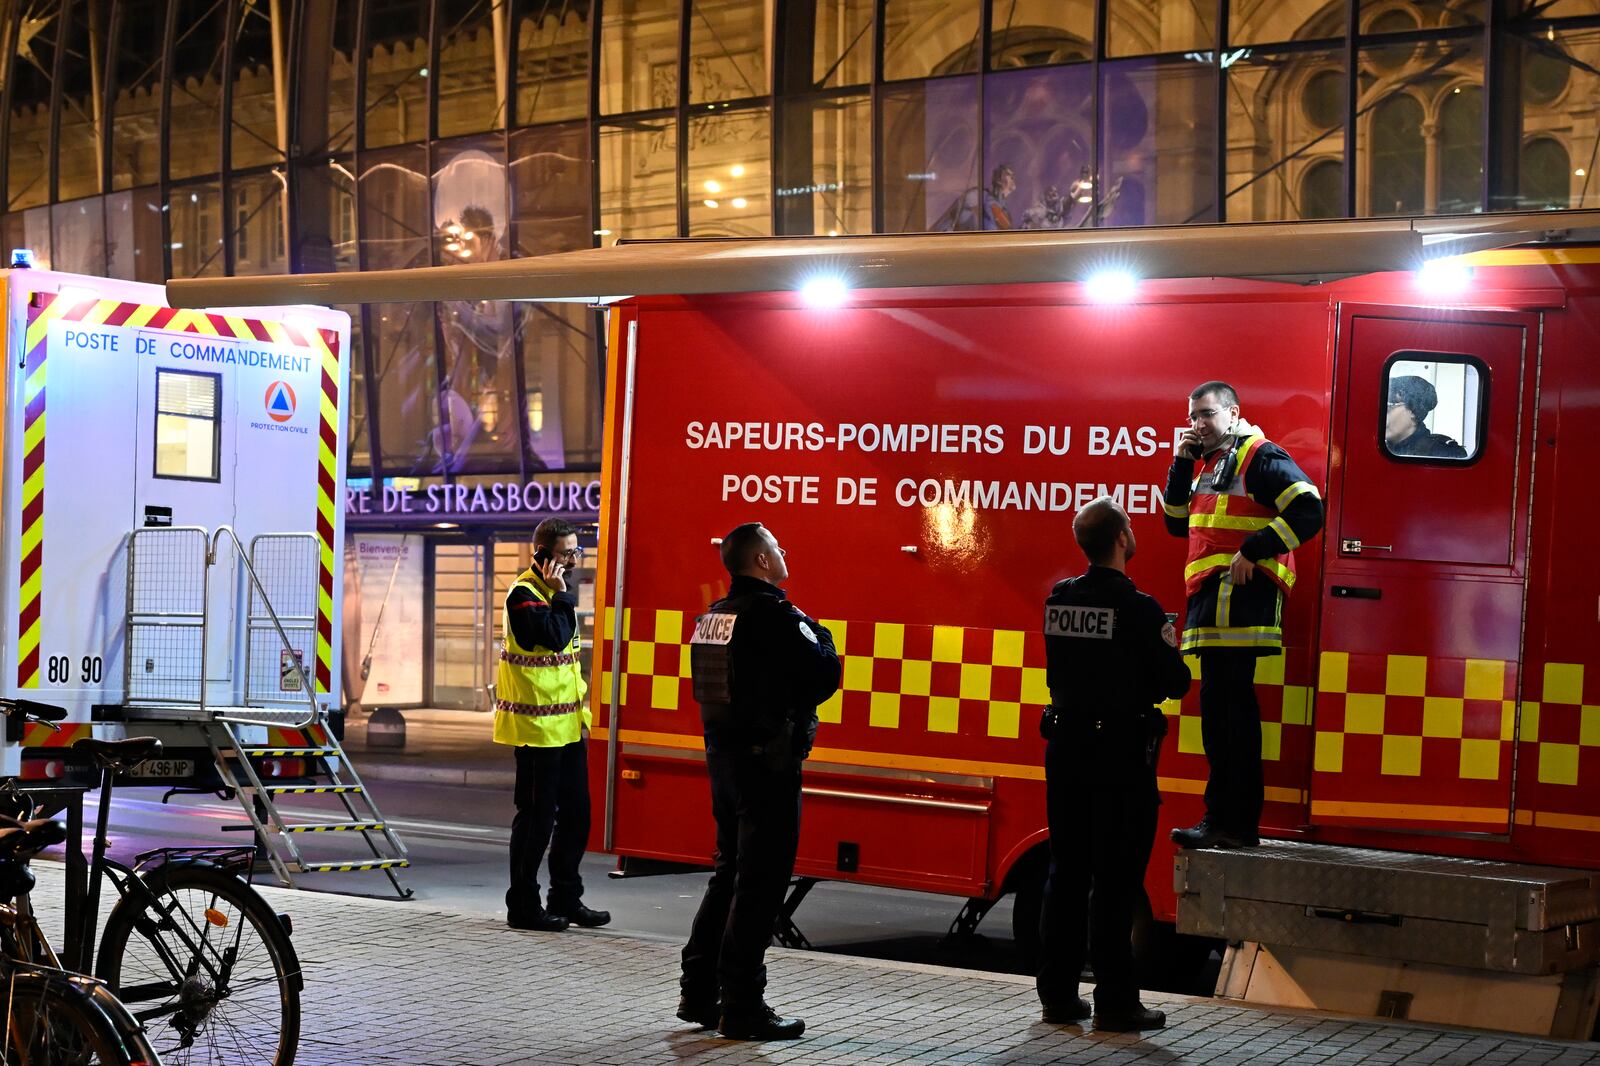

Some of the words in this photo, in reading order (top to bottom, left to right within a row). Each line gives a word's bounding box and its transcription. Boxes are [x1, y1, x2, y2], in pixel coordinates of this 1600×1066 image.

[65, 330, 119, 352] POSTE
[136, 337, 156, 356] DE
[171, 342, 312, 373] COMMANDEMENT
[251, 422, 288, 432] PROTECTION
[290, 426, 308, 434] CIVILE
[686, 421, 1005, 455] SAPEURS-POMPIERS
[1024, 425, 1072, 456] DU
[383, 486, 413, 513] DE
[722, 474, 820, 505] POSTE
[836, 477, 878, 507] DE
[1048, 609, 1109, 635] POLICE
[48, 656, 70, 684] 80
[82, 656, 103, 684] 90
